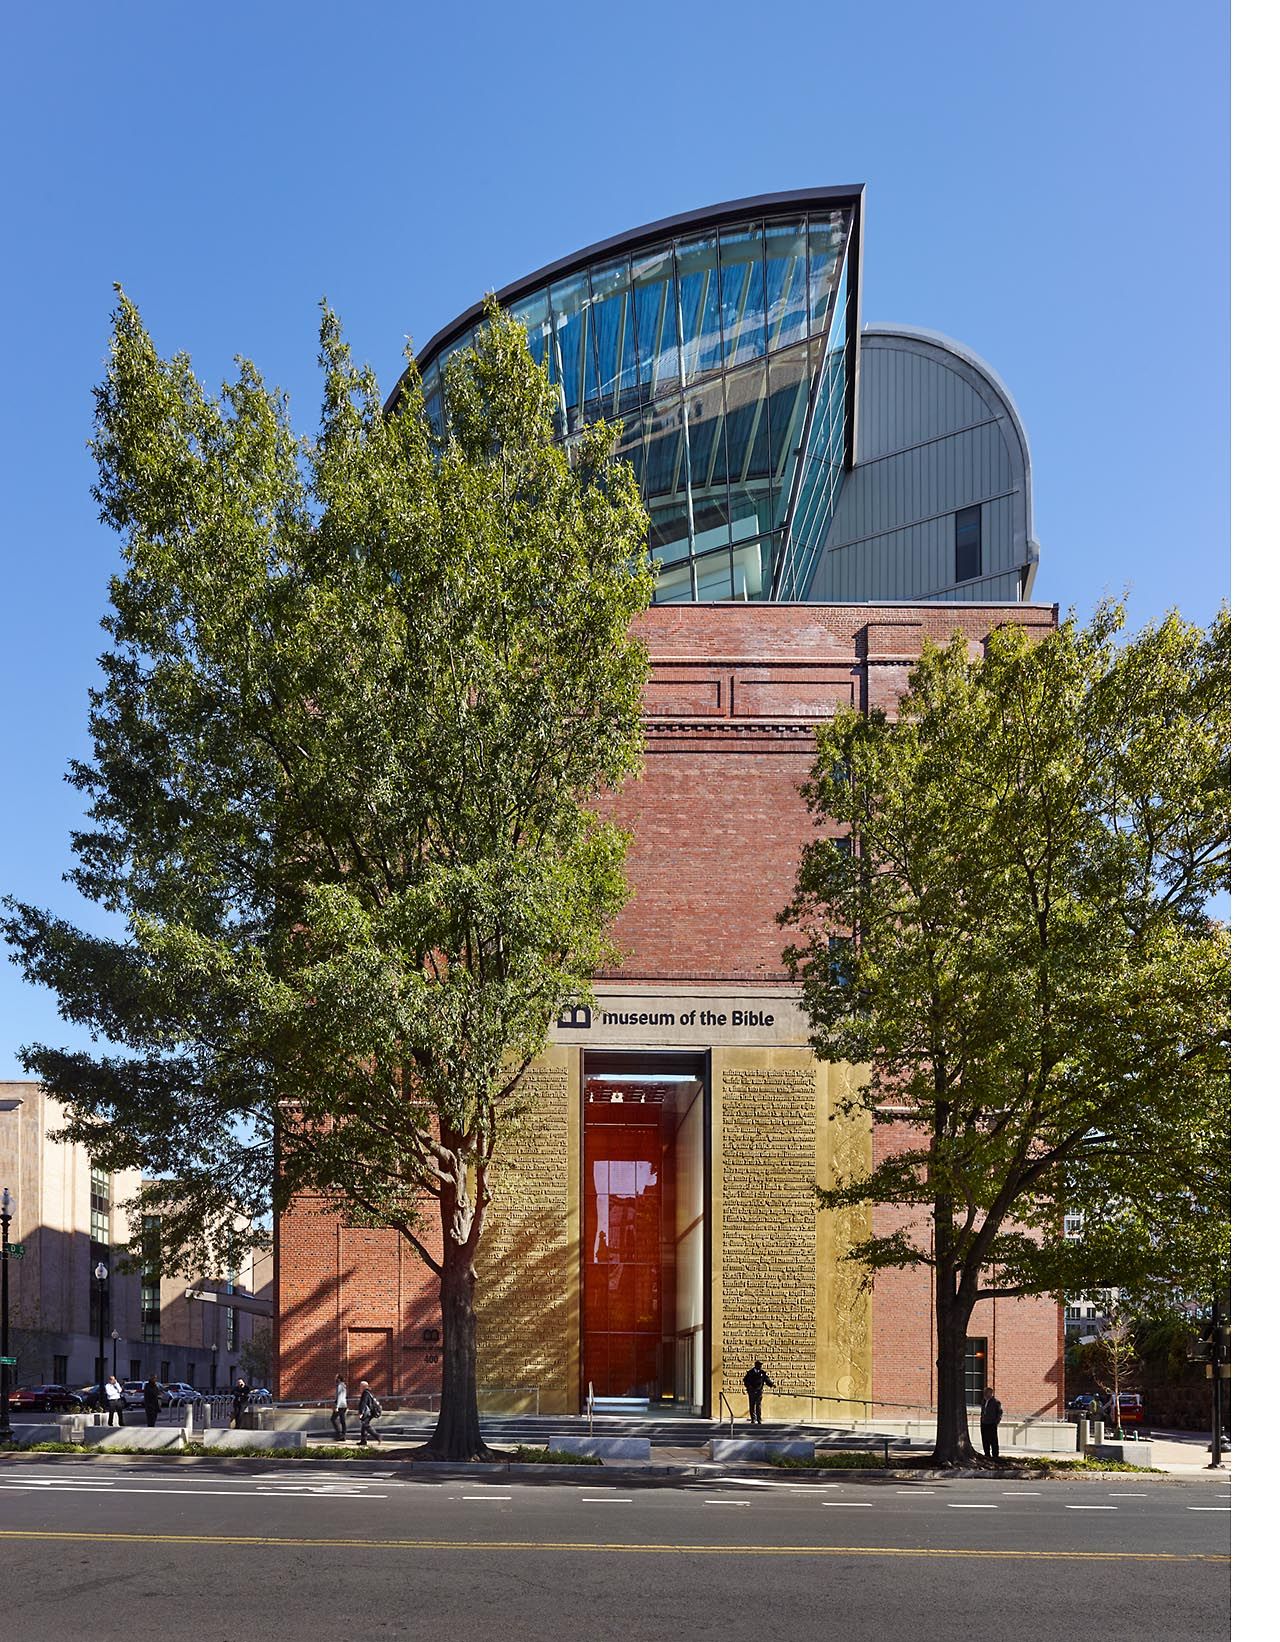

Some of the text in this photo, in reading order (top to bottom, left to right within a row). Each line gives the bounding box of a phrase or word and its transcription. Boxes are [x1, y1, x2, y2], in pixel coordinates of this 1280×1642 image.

[602, 1010, 675, 1026] museum
[679, 1010, 696, 1026] of
[700, 1010, 727, 1026] the
[731, 1010, 775, 1027] Bible
